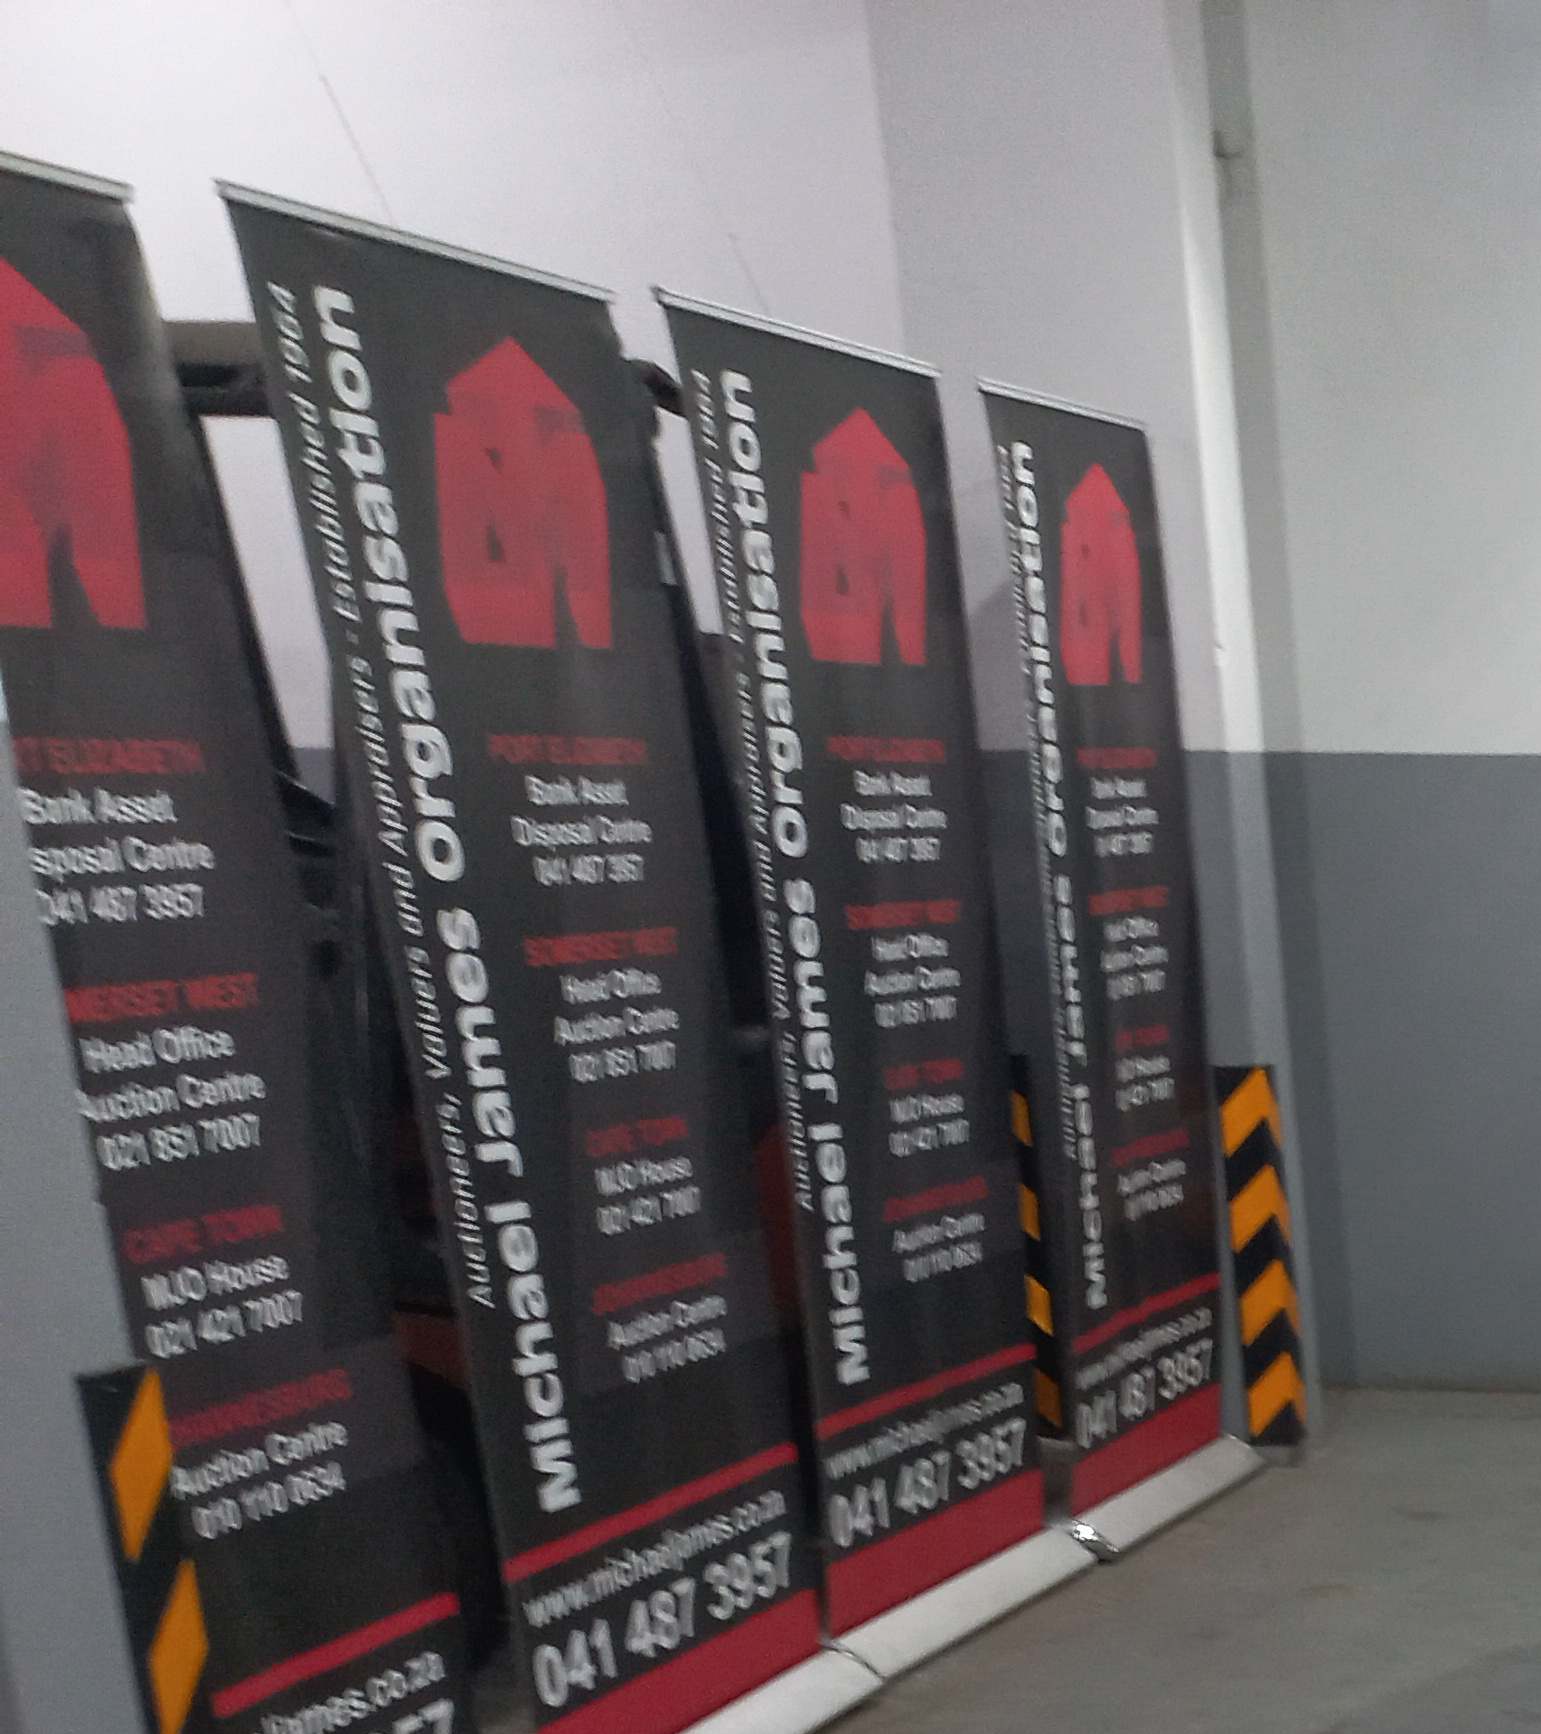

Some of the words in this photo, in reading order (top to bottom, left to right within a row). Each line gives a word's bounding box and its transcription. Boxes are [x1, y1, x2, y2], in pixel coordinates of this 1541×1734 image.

[286, 390, 362, 624] Established
[311, 283, 466, 883] Organisation
[719, 367, 810, 859] Organisation
[1010, 439, 1069, 858] Organisation
[93, 785, 178, 825] Asset
[346, 653, 409, 858] Appraisers
[29, 836, 125, 884] sposal
[121, 836, 216, 872] Centre
[381, 861, 425, 938] and
[152, 1025, 237, 1065] Office
[403, 944, 453, 1080] Valuers
[436, 906, 525, 1178] James
[781, 878, 839, 1105] James
[1052, 873, 1088, 1068] James
[176, 1071, 266, 1108] Centre
[807, 1121, 871, 1386] Michael
[1071, 1081, 1108, 1310] Michael
[264, 1420, 349, 1466] Centre
[483, 1199, 583, 1514] Michael
[827, 1476, 890, 1548] 041
[894, 1450, 950, 1514] 487
[531, 1617, 618, 1708] 041
[624, 1576, 697, 1658] 487
[703, 1531, 793, 1621] 3957
